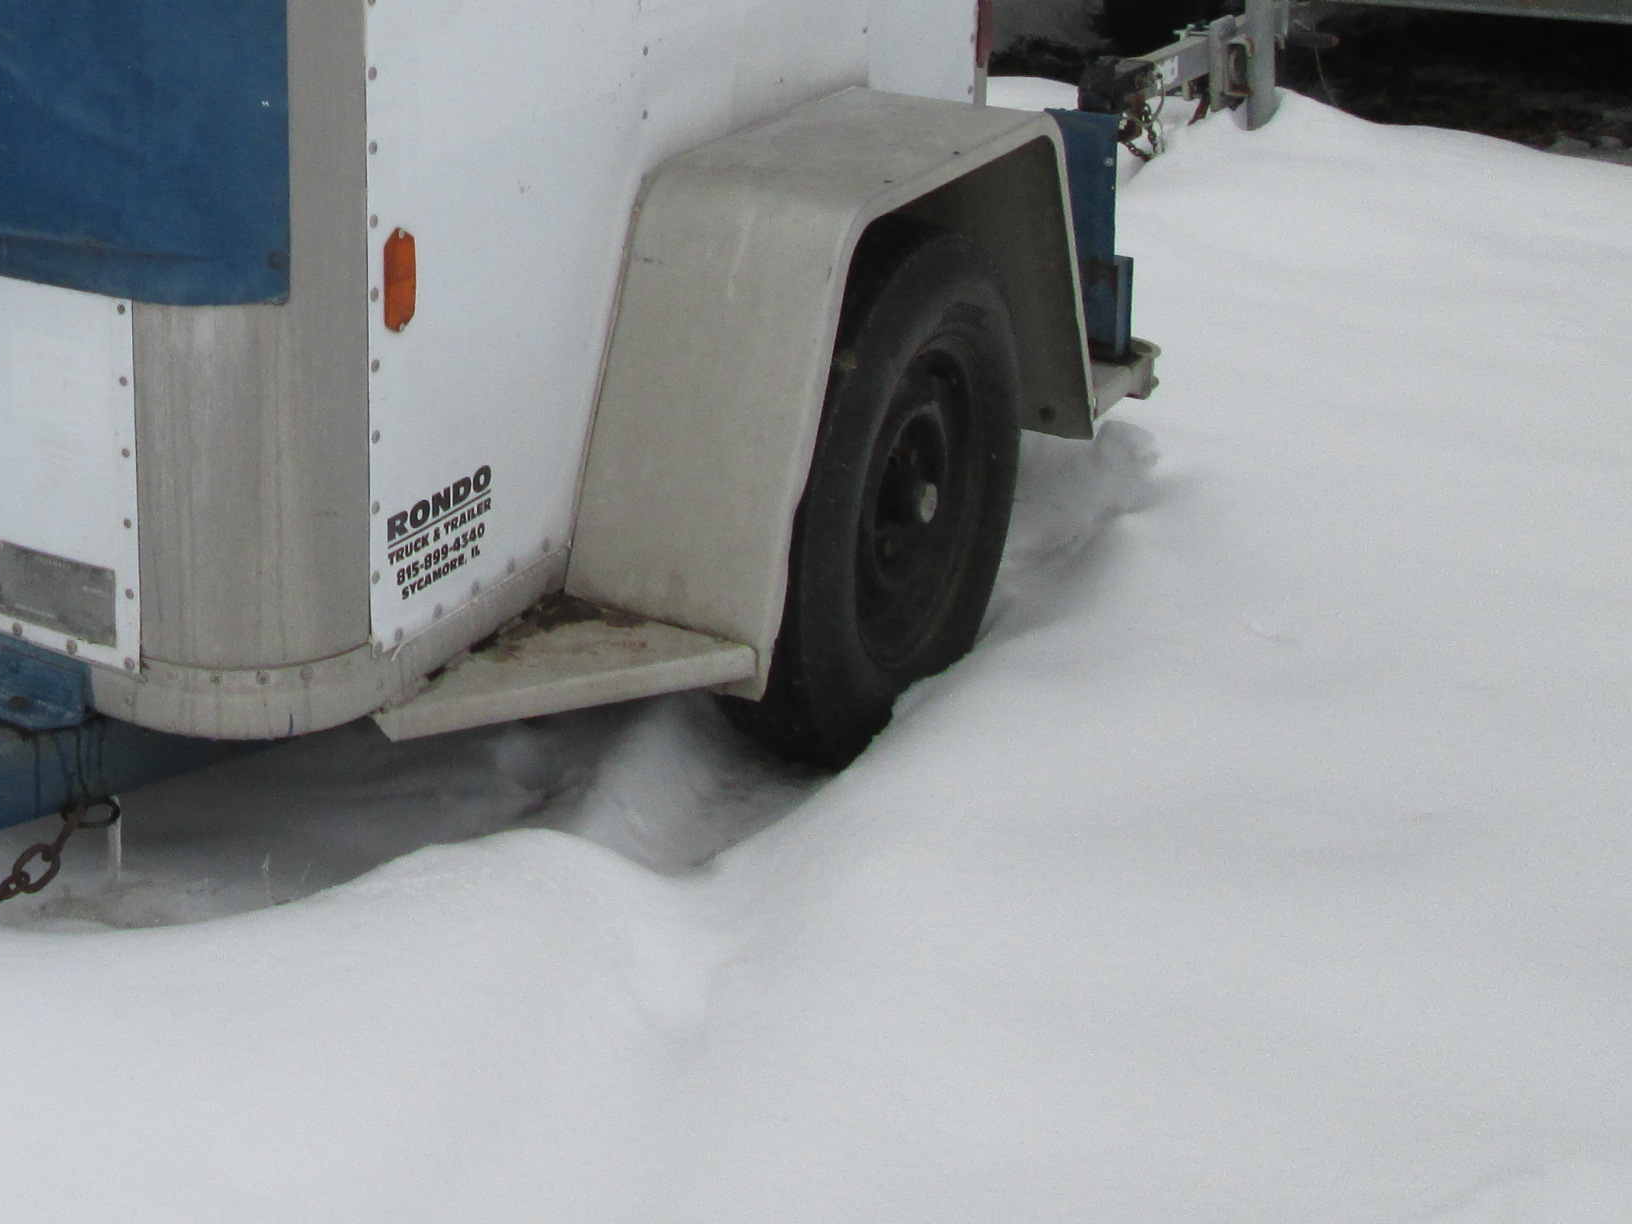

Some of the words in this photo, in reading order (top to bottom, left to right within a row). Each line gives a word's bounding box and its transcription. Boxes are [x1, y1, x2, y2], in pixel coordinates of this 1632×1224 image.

[387, 464, 492, 542] RONDO
[388, 533, 430, 566] TRUCK
[433, 527, 441, 542] &
[444, 497, 492, 535] TRAILER
[396, 522, 485, 586] 815-899-4340
[402, 553, 467, 600] SYCAMORE,
[471, 545, 480, 559] IL
